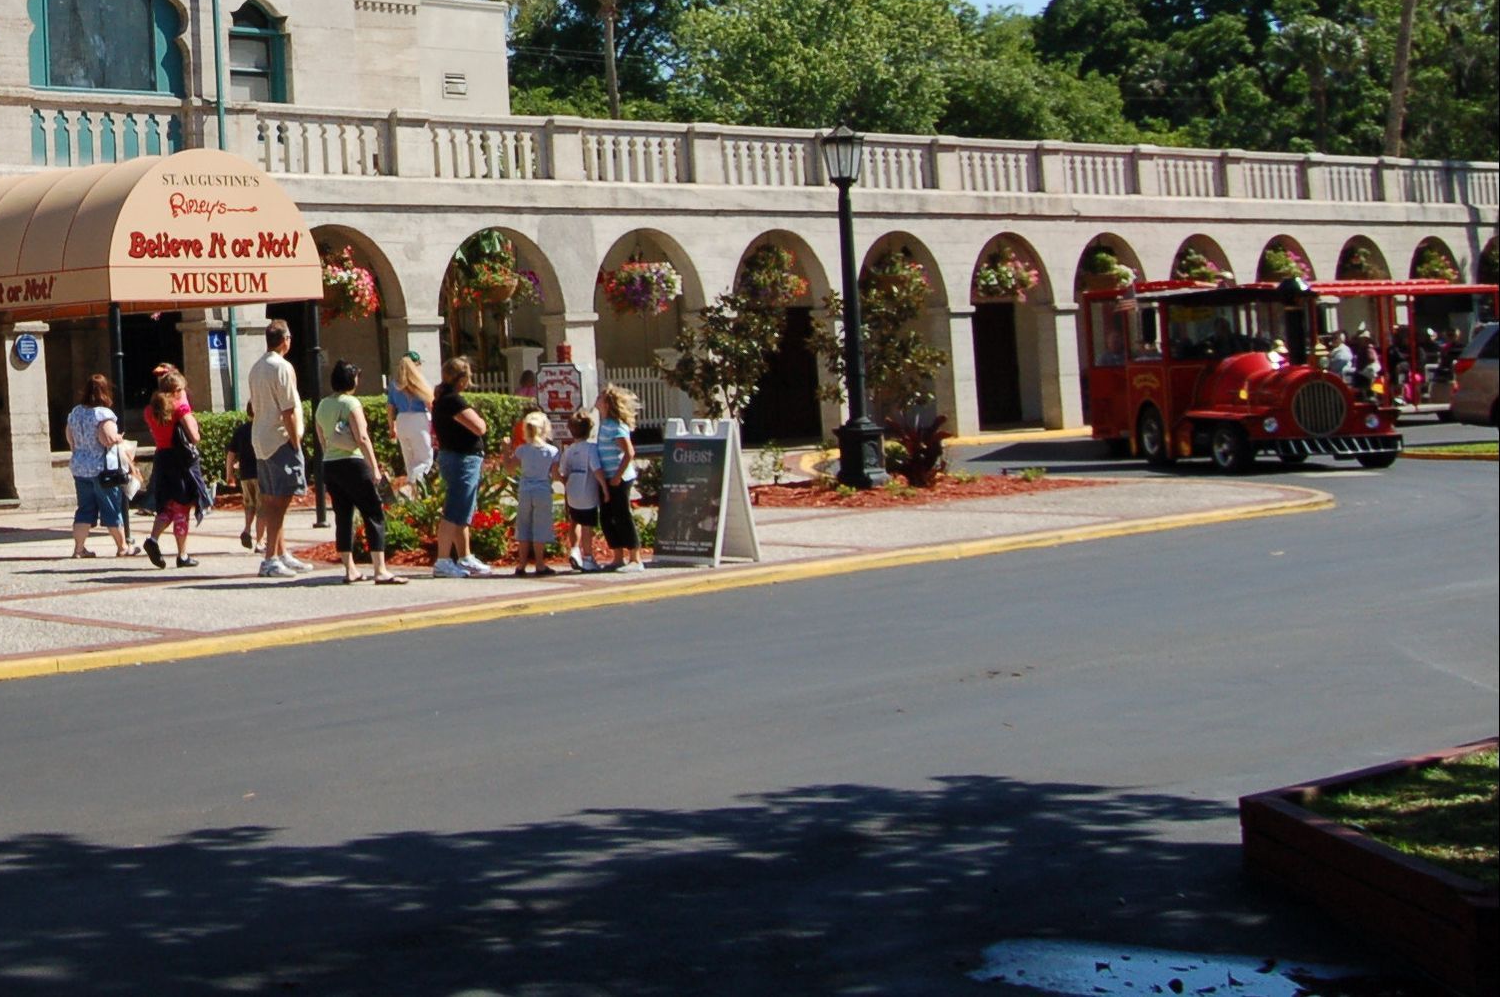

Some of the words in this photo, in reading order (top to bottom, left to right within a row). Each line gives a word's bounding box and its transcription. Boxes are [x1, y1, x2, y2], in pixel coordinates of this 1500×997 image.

[162, 174, 179, 186] ST.
[183, 175, 260, 187] AUGUSTINE'S
[128, 231, 203, 259] Believe
[208, 231, 227, 258] It
[231, 238, 253, 258] or
[257, 231, 299, 258] Not!
[7, 285, 23, 302] or
[24, 274, 54, 302] Not!
[170, 272, 268, 294] MUSEUM
